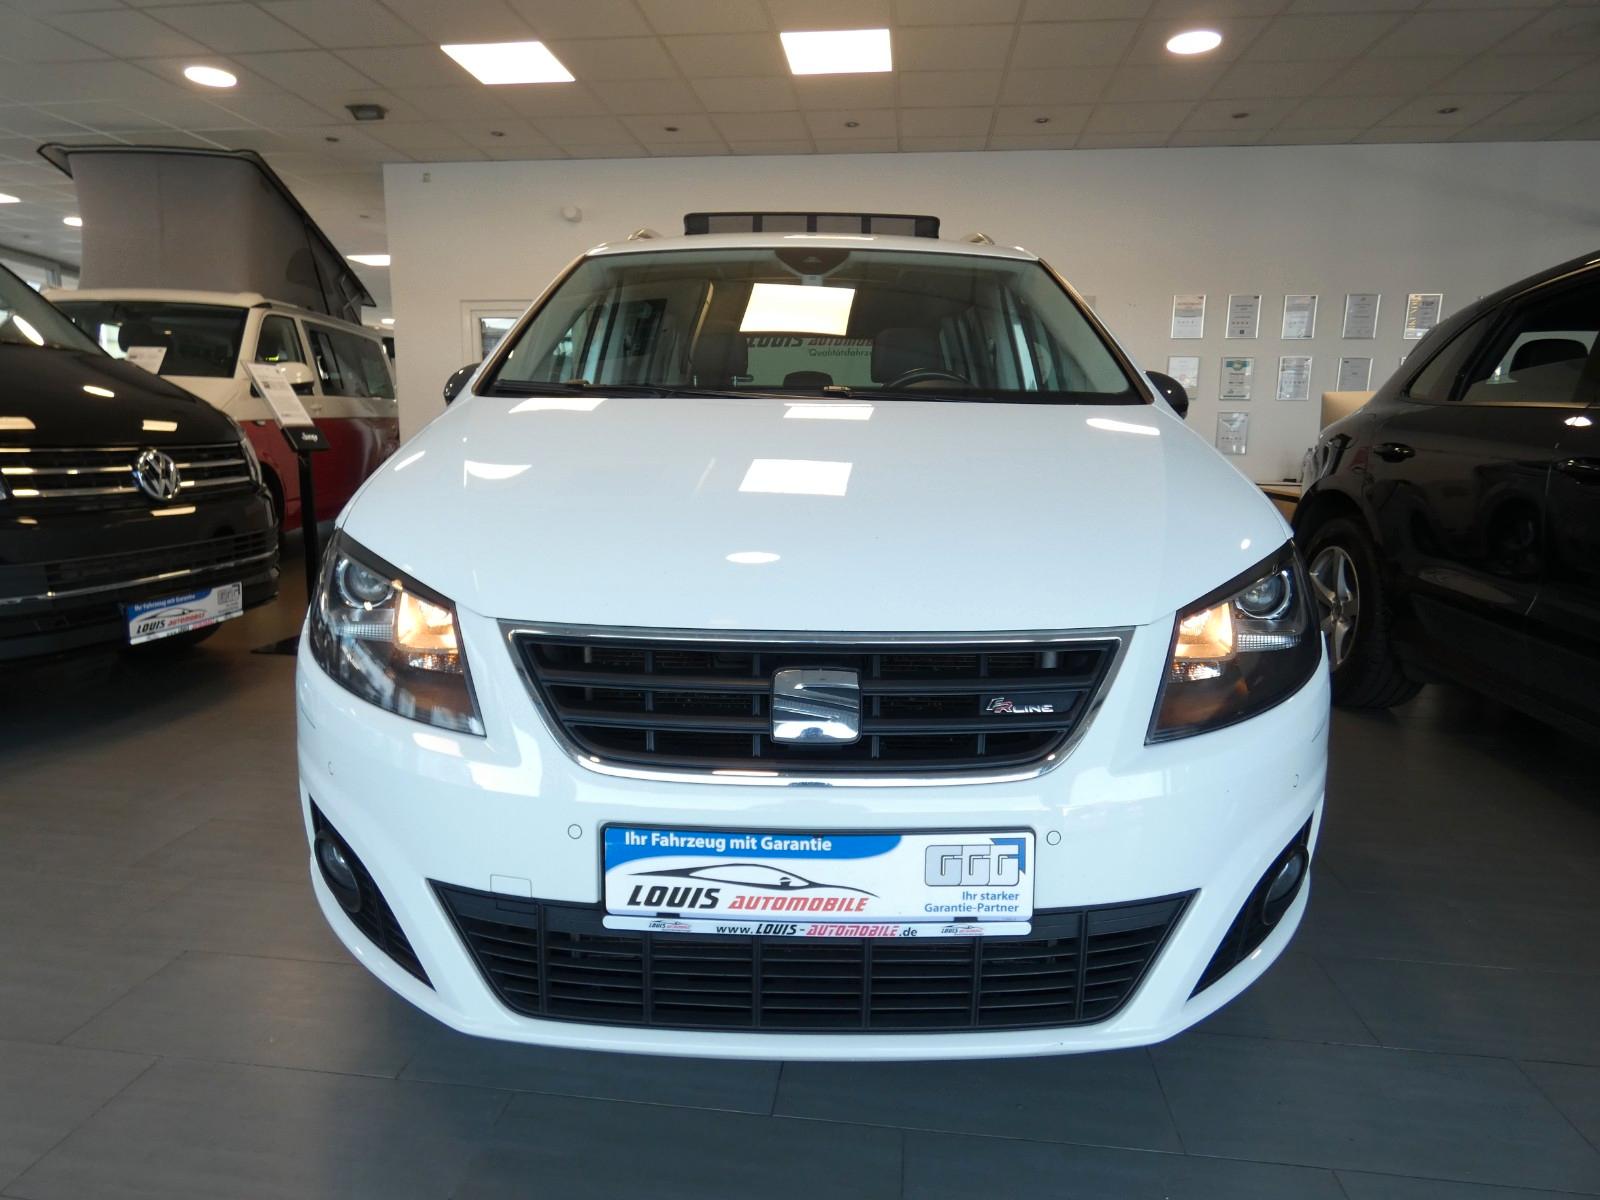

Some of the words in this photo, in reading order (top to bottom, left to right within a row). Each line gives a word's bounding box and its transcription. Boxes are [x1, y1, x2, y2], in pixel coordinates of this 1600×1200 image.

[136, 620, 165, 634] LOUIS
[625, 831, 647, 846] Ihr
[651, 832, 726, 852] Fahrzeug
[730, 835, 757, 850] mit
[761, 836, 832, 851] Garantie
[627, 885, 721, 910] LOUIS
[728, 895, 870, 912] AUTOMOBILE
[962, 891, 977, 901] Ihr
[980, 891, 1020, 901] starker
[924, 903, 1020, 914] Garantie-Partner
